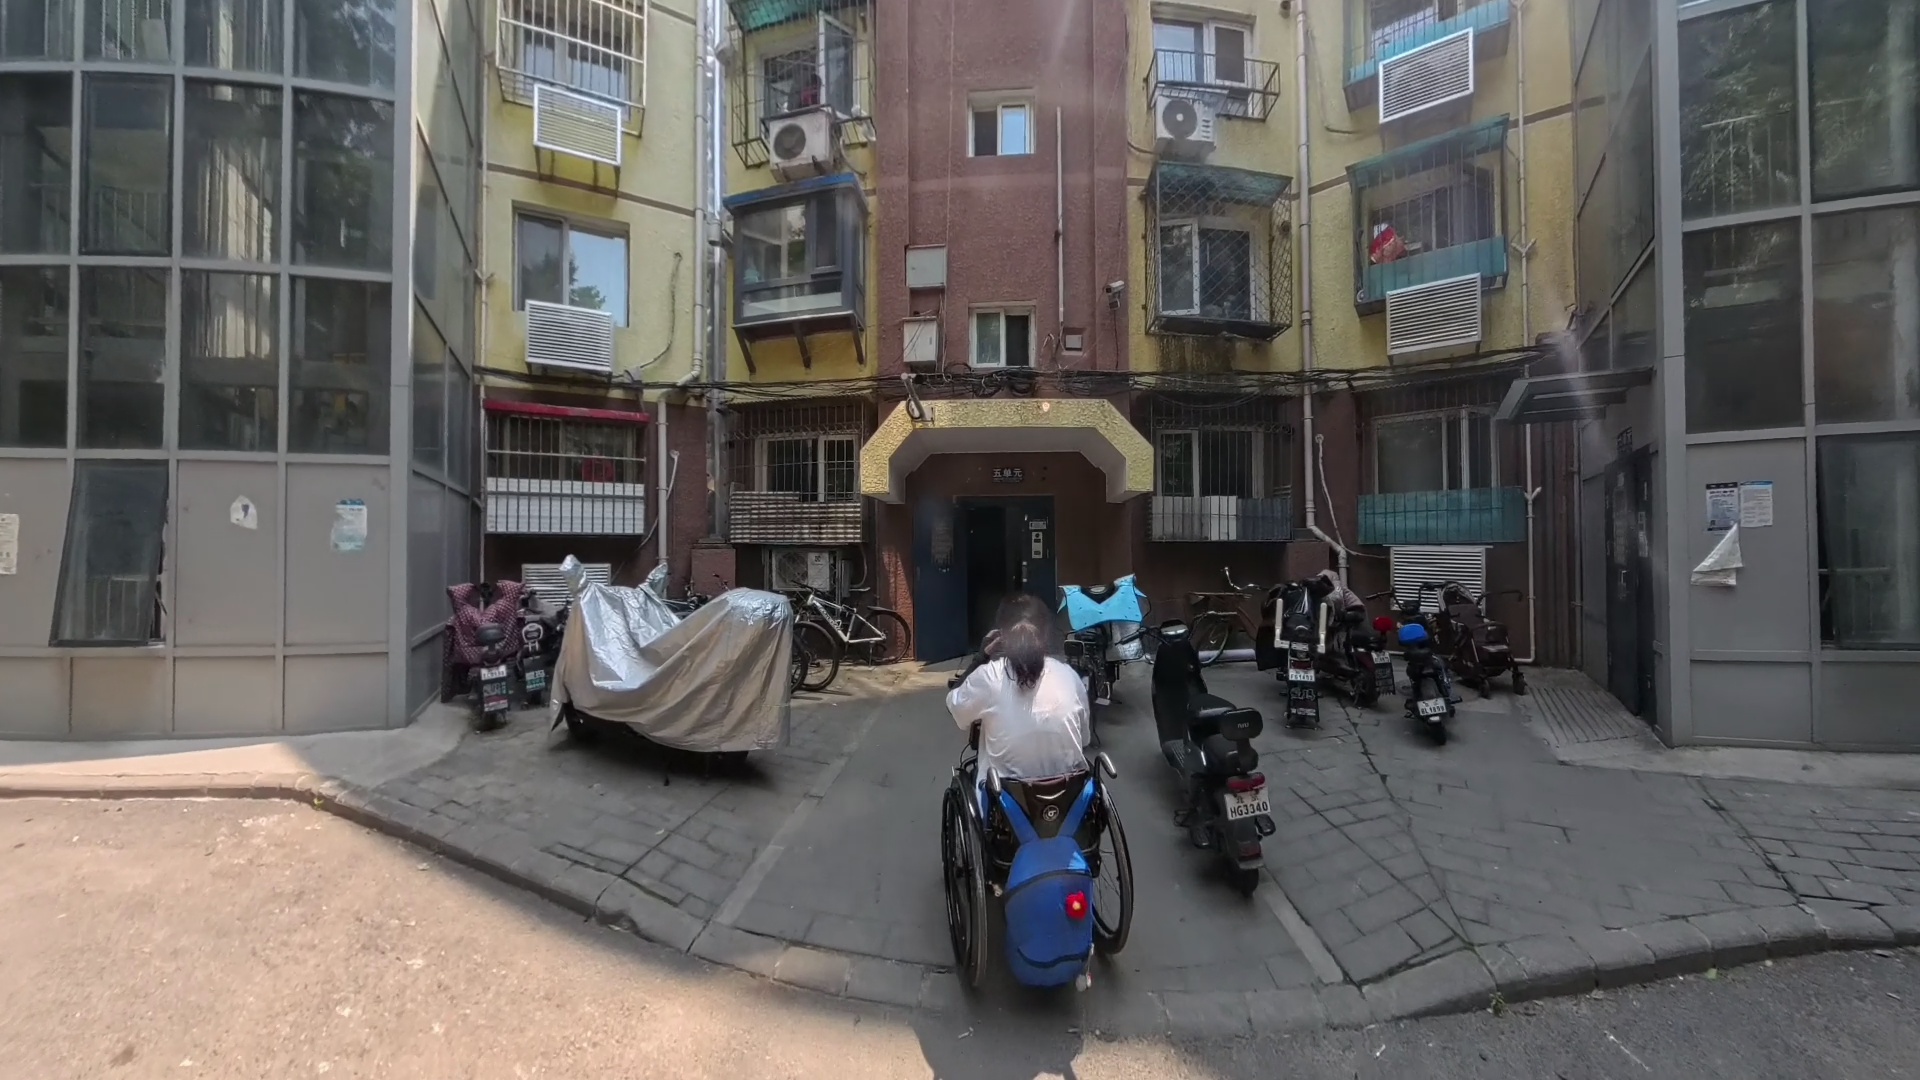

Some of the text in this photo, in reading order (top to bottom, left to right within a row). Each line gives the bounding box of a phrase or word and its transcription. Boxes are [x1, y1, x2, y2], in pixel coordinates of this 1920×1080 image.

[993, 468, 1022, 477] 五单元
[1230, 801, 1268, 818] HG3340
